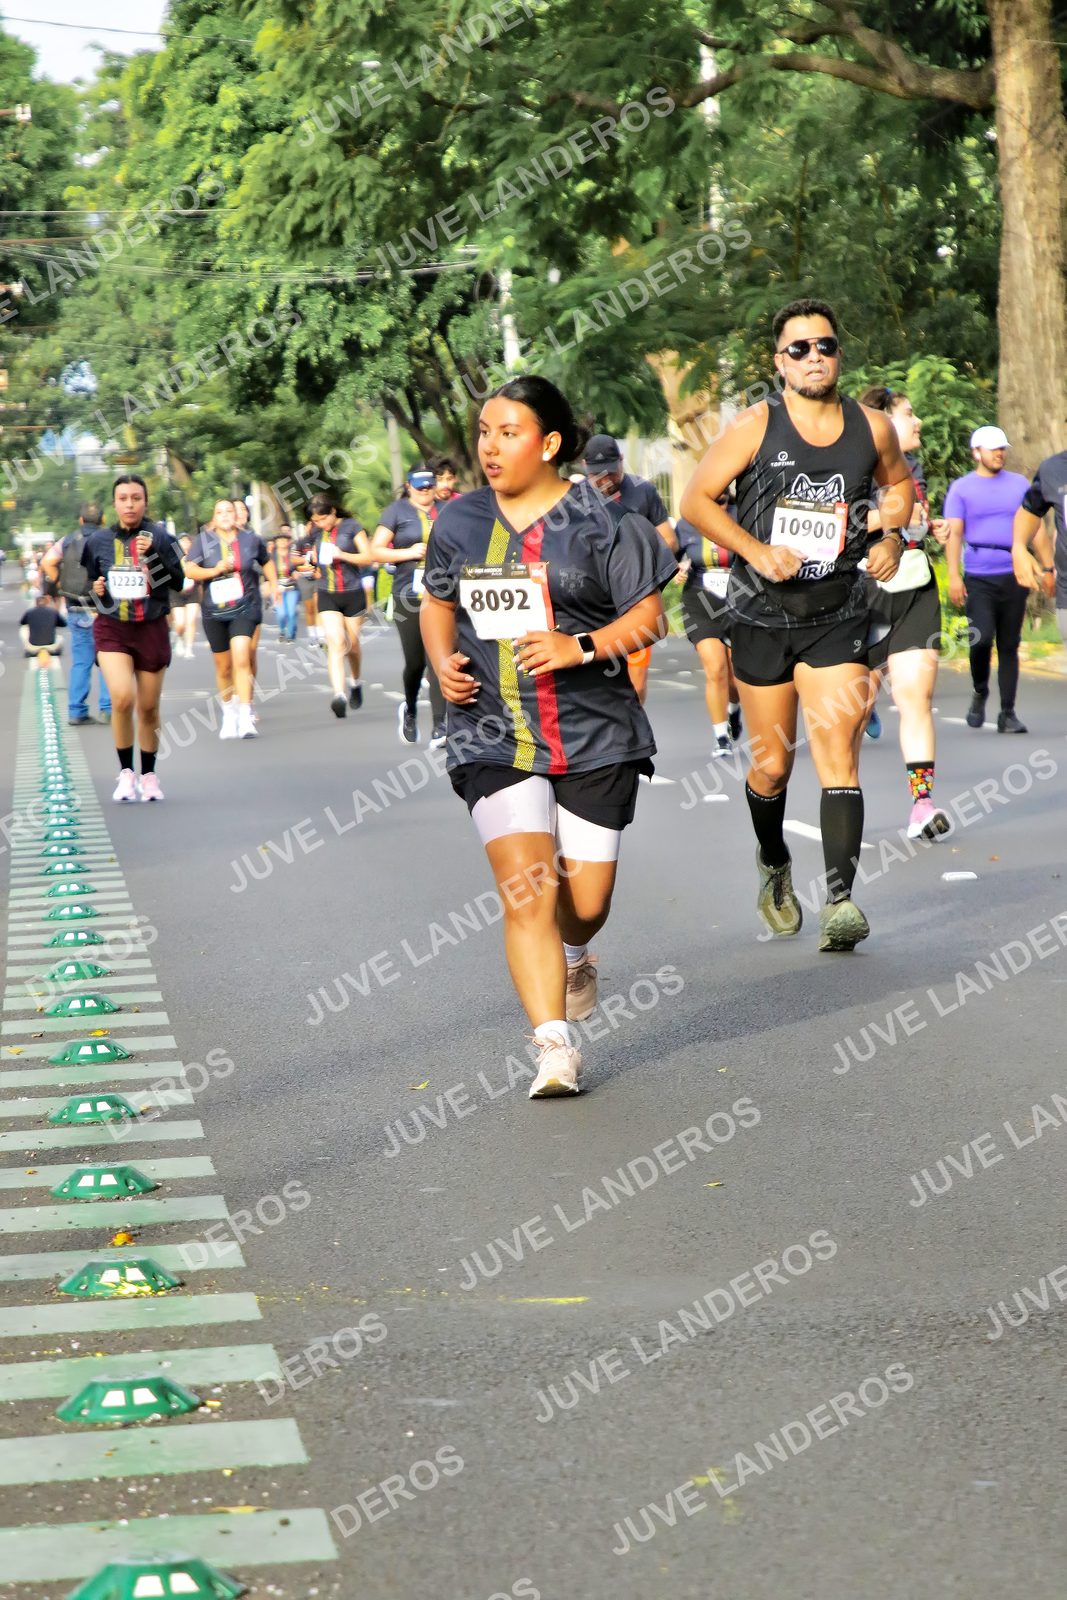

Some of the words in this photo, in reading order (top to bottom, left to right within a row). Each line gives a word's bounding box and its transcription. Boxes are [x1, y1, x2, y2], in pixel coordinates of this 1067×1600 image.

[778, 516, 836, 540] 10900
[111, 575, 144, 587] 12232
[470, 588, 531, 612] 8092
